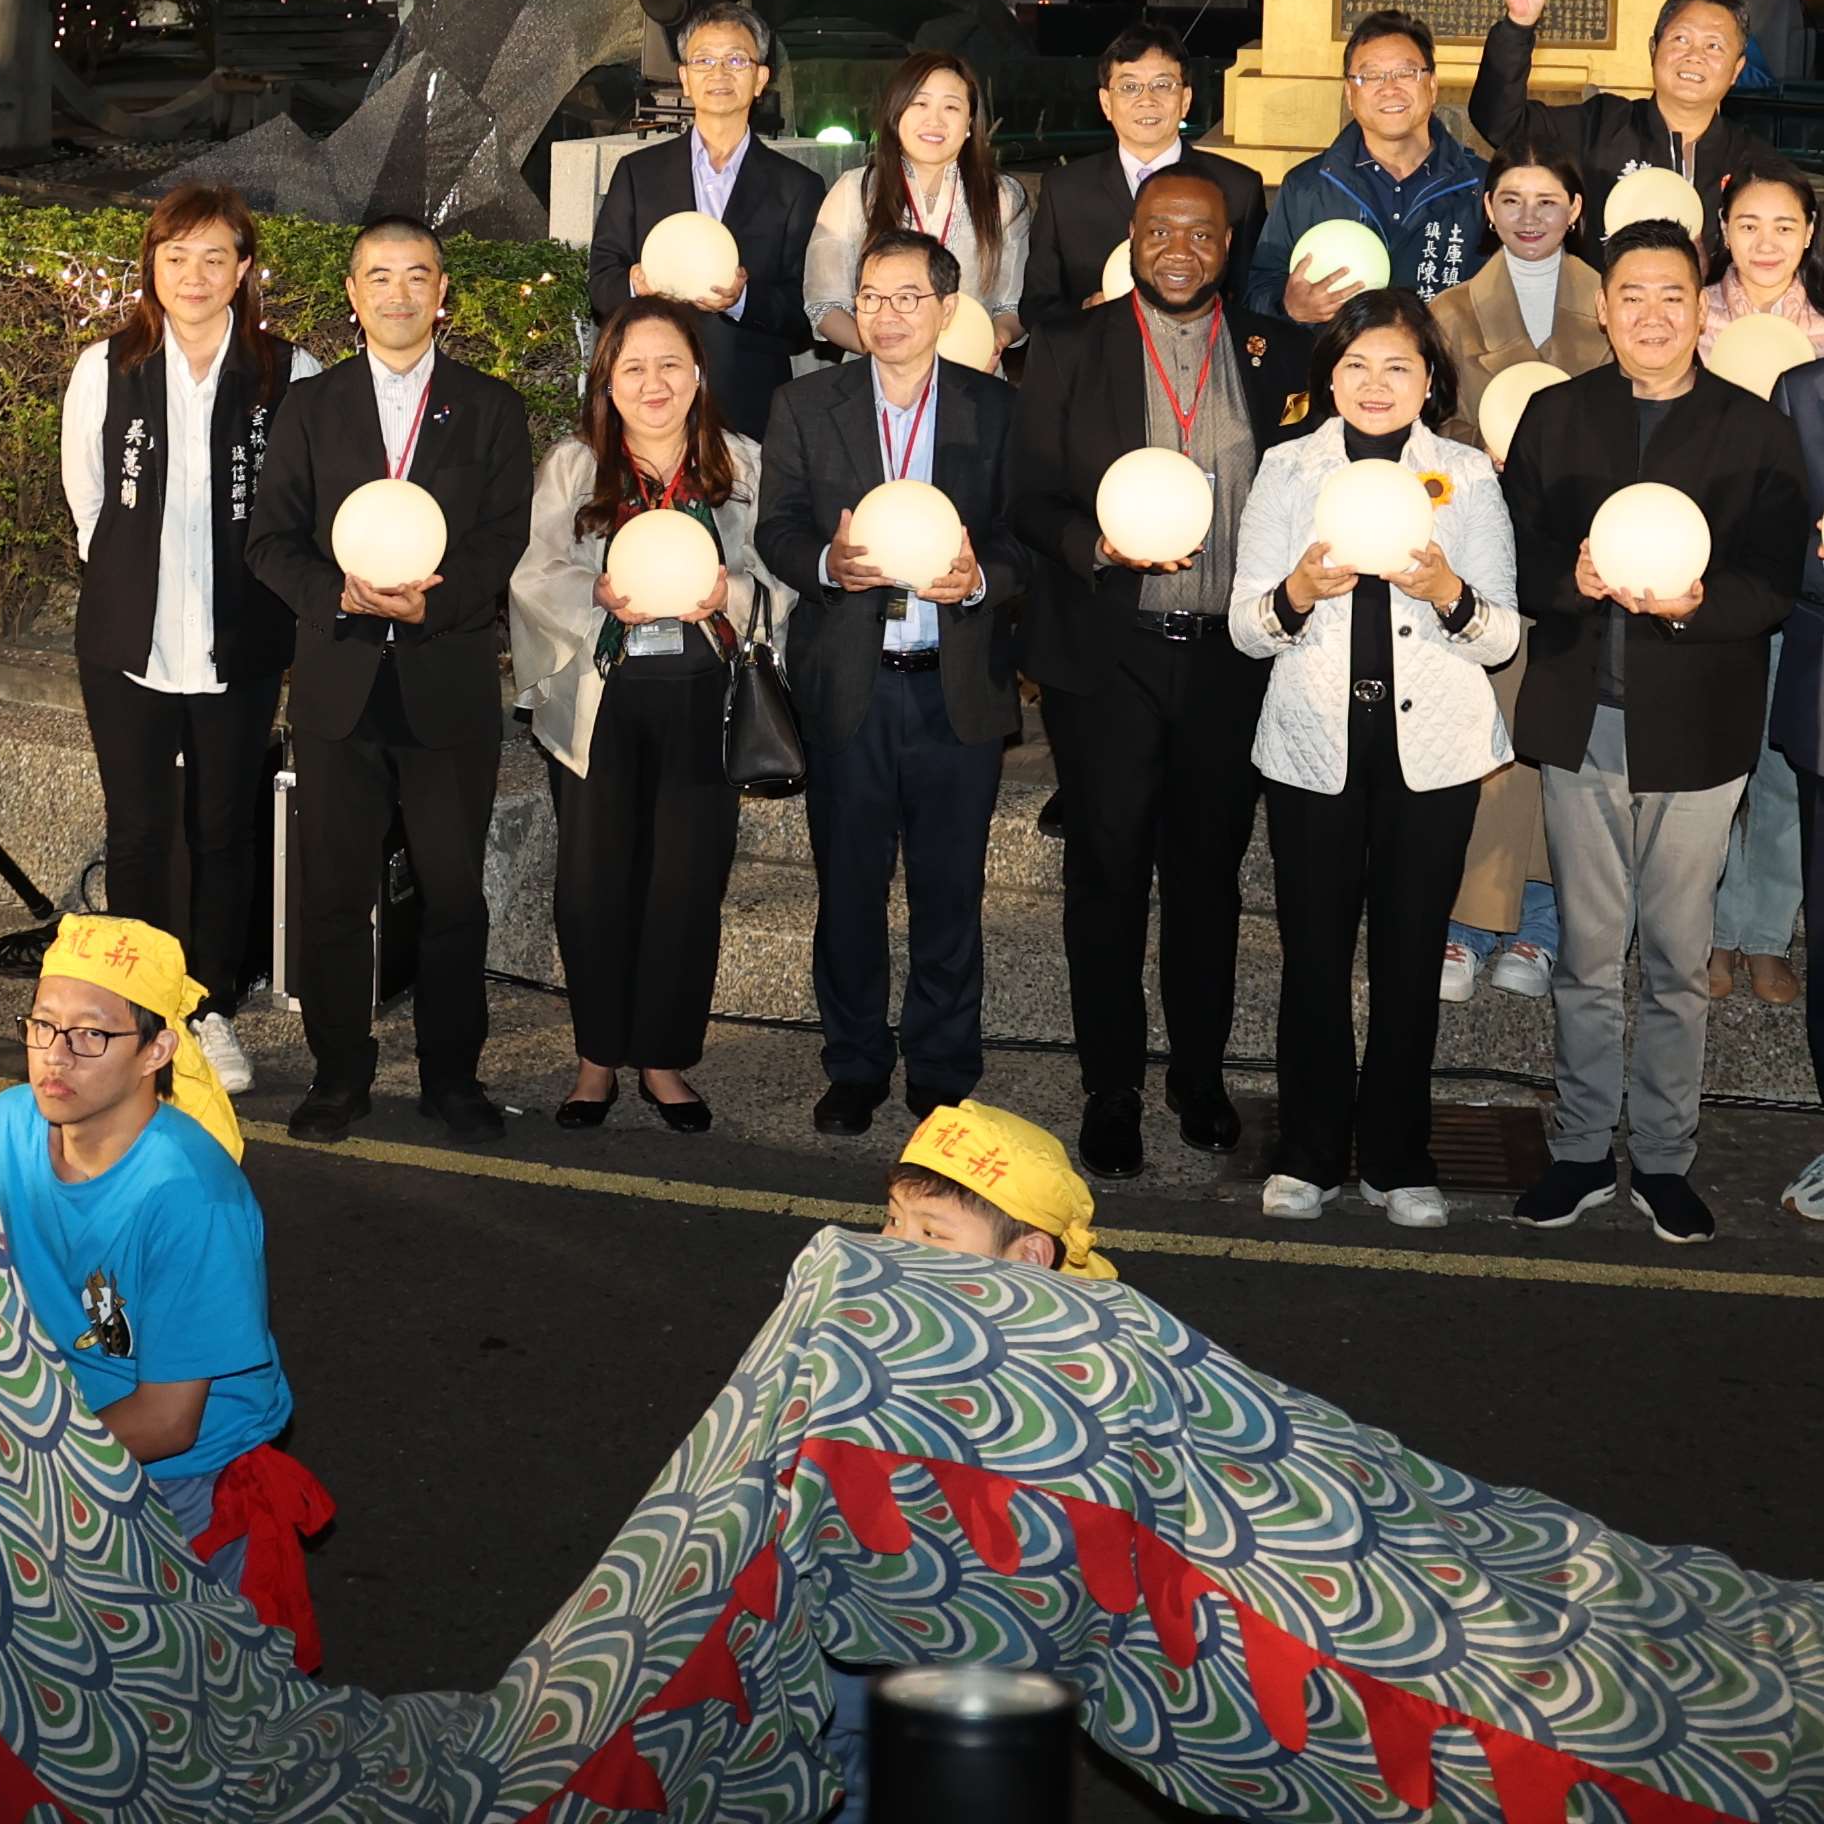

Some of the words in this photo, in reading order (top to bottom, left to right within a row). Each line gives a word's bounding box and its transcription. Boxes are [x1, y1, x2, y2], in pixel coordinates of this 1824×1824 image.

[1441, 222, 1465, 287] 土庫鎮
[230, 444, 249, 521] 誠信聯盟
